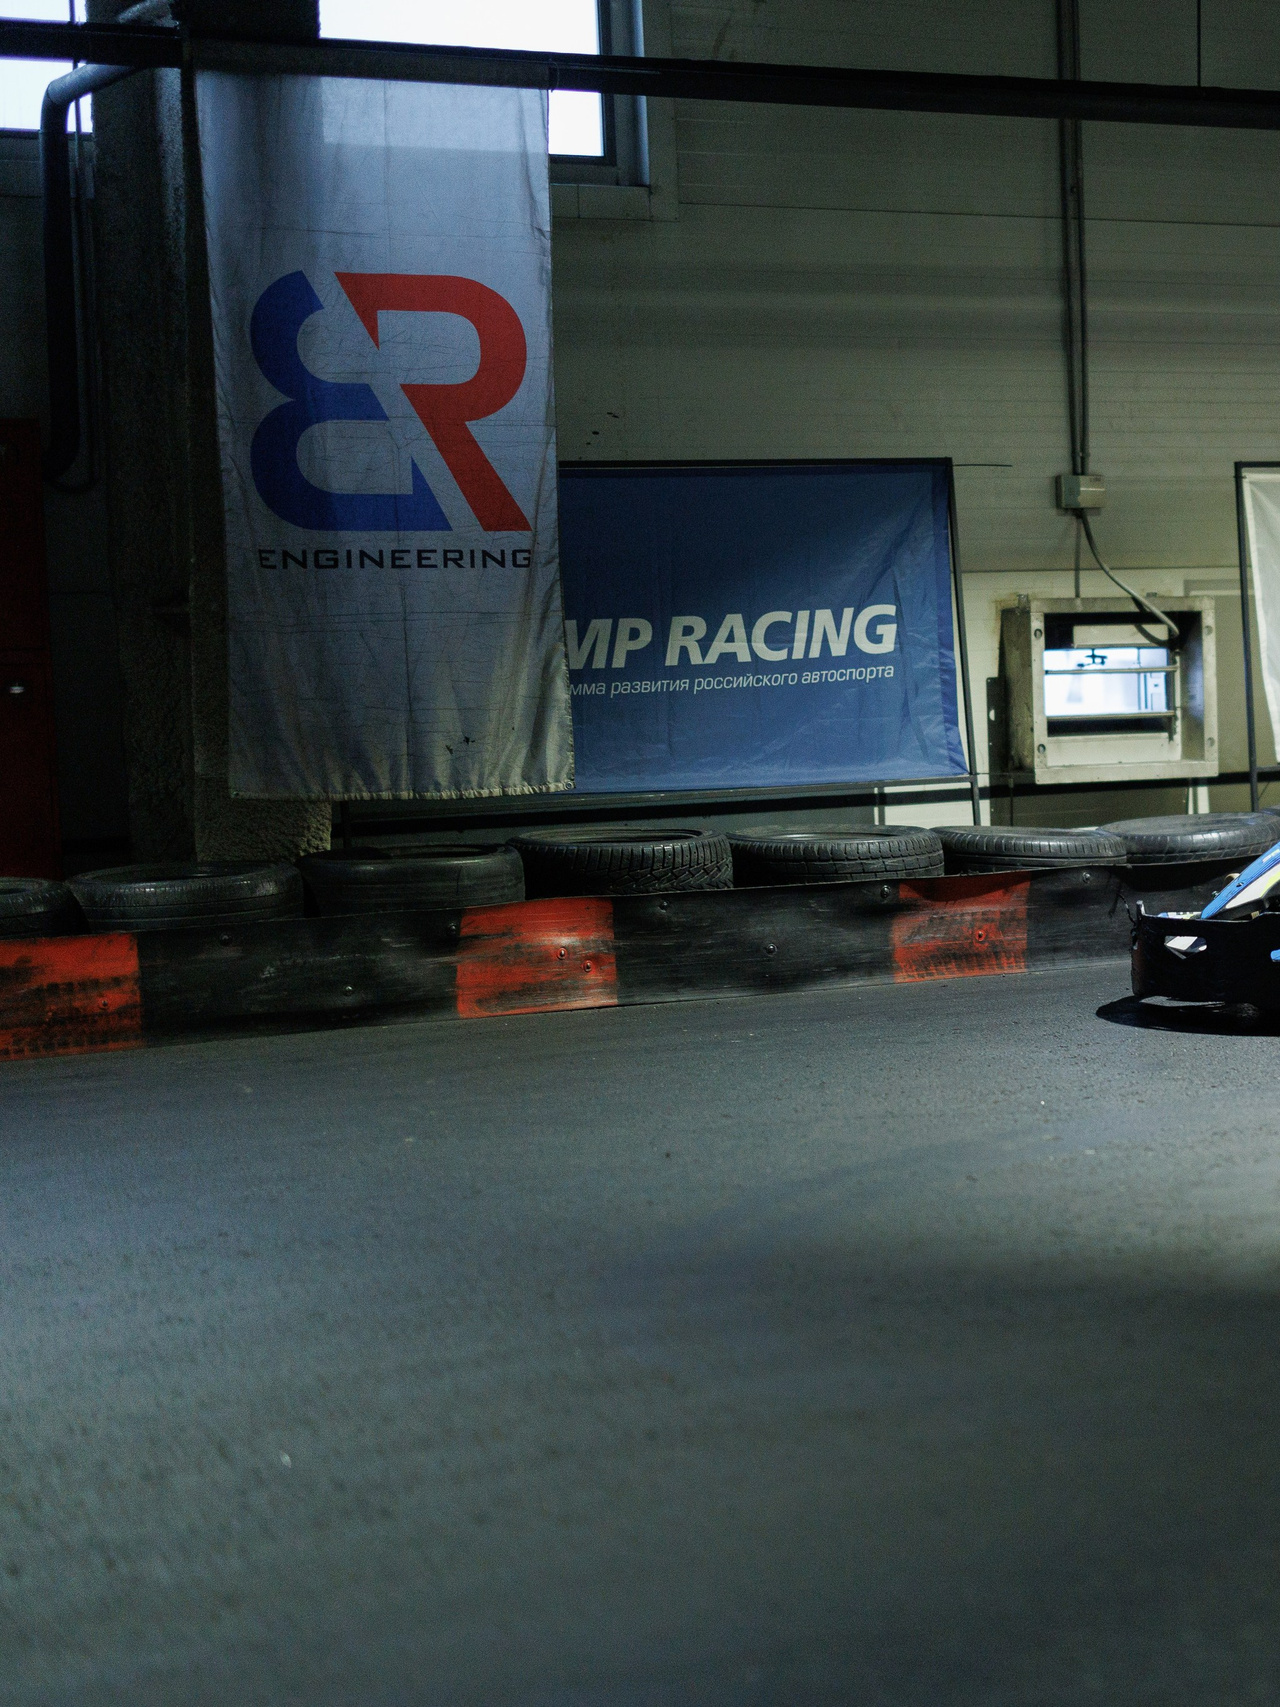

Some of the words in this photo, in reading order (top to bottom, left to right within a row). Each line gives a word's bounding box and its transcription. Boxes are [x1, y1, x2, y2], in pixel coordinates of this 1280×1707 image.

[258, 548, 533, 570] ENGINEERING
[565, 617, 653, 671] MP
[665, 604, 898, 667] RACING
[610, 679, 689, 699] развития
[694, 670, 798, 694] российского
[801, 665, 895, 687] автоспорта
